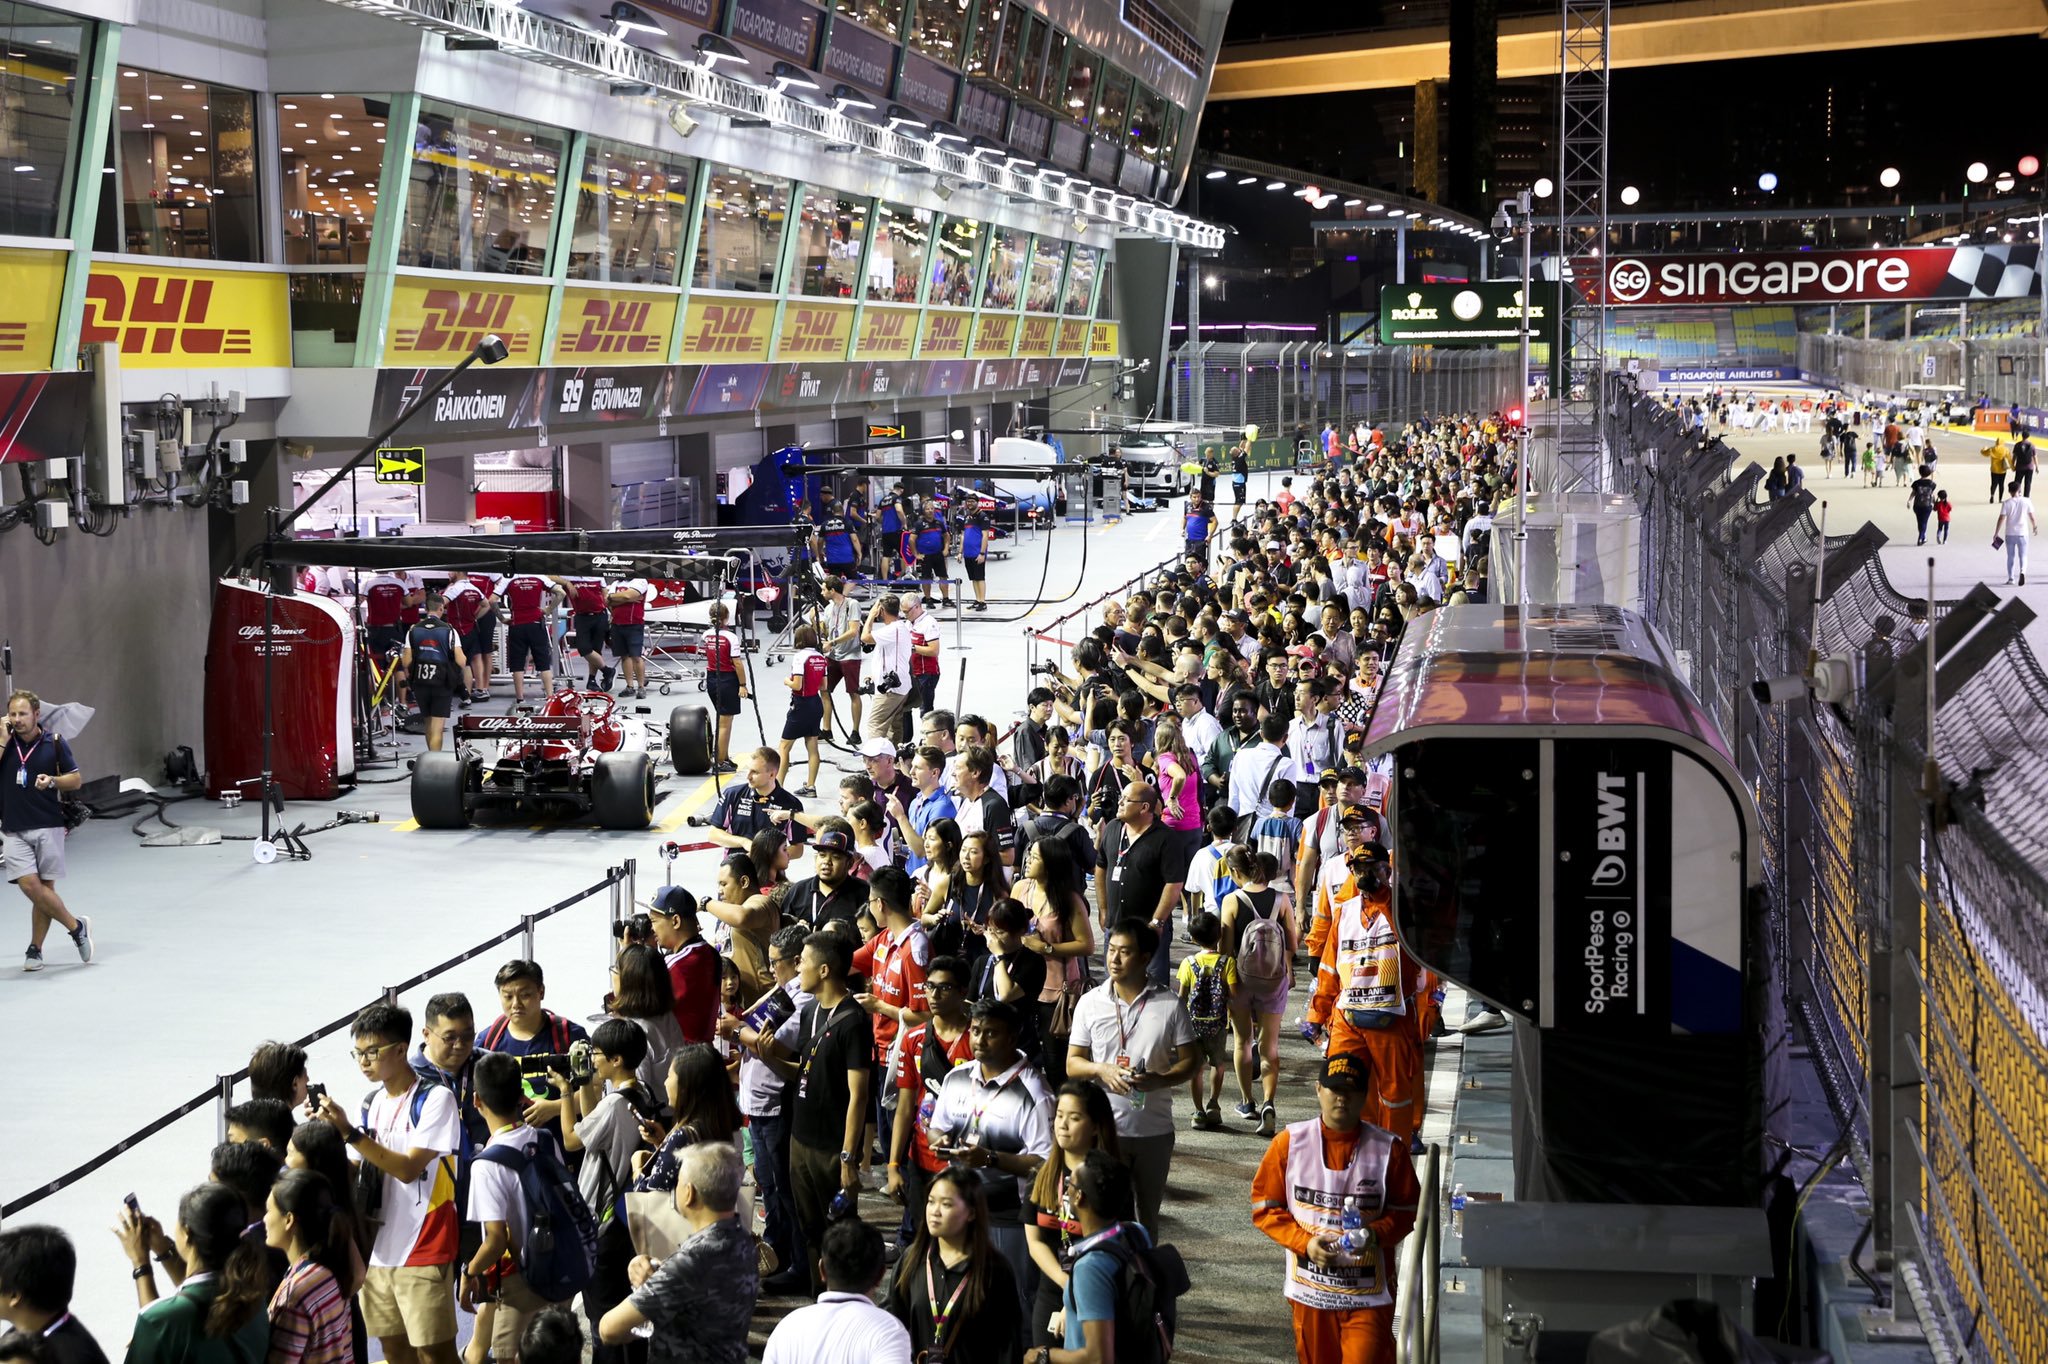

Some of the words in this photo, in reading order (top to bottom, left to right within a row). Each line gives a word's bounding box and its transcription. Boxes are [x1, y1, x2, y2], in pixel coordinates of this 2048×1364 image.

[775, 24, 809, 55] AIRLINES
[1615, 270, 1645, 290] SG
[80, 273, 225, 354] DHL
[414, 289, 515, 353] DHL
[1392, 308, 1438, 320] ROLEX
[576, 299, 652, 353] DHL
[697, 305, 756, 352] DHL
[789, 309, 838, 351] DHL
[865, 311, 906, 351] DHL
[922, 316, 961, 351] DHL
[978, 319, 1008, 351] DHL
[873, 376, 890, 392] GASLY
[1727, 370, 1774, 380] AIRLINES
[560, 378, 584, 412] 99
[591, 386, 643, 410] GIOVINAZZI
[800, 380, 822, 398] KVYAT
[434, 389, 506, 422] RÄIKKÖNEN
[673, 531, 690, 542] Alfa
[690, 530, 717, 539] Romeo
[592, 556, 611, 567] Alfa
[610, 556, 634, 566] Romeo
[238, 626, 266, 640] Alfa
[271, 624, 307, 636] Romeo
[418, 664, 436, 680] 137
[478, 718, 515, 731] Alfa
[514, 716, 566, 730] Romeo
[1597, 771, 1626, 851] BWT
[1584, 910, 1610, 1014] SportPesa
[1611, 930, 1634, 998] Racing
[1347, 988, 1361, 997] PIT
[1362, 986, 1386, 996] LANE
[1308, 1262, 1323, 1274] PIT
[1327, 1266, 1361, 1277] LANE
[1310, 1274, 1326, 1284] ALL
[1292, 1294, 1323, 1308] SINGAPORE
[1302, 1292, 1338, 1304] SINGAPORE
[1315, 1291, 1346, 1300] FORMULA
